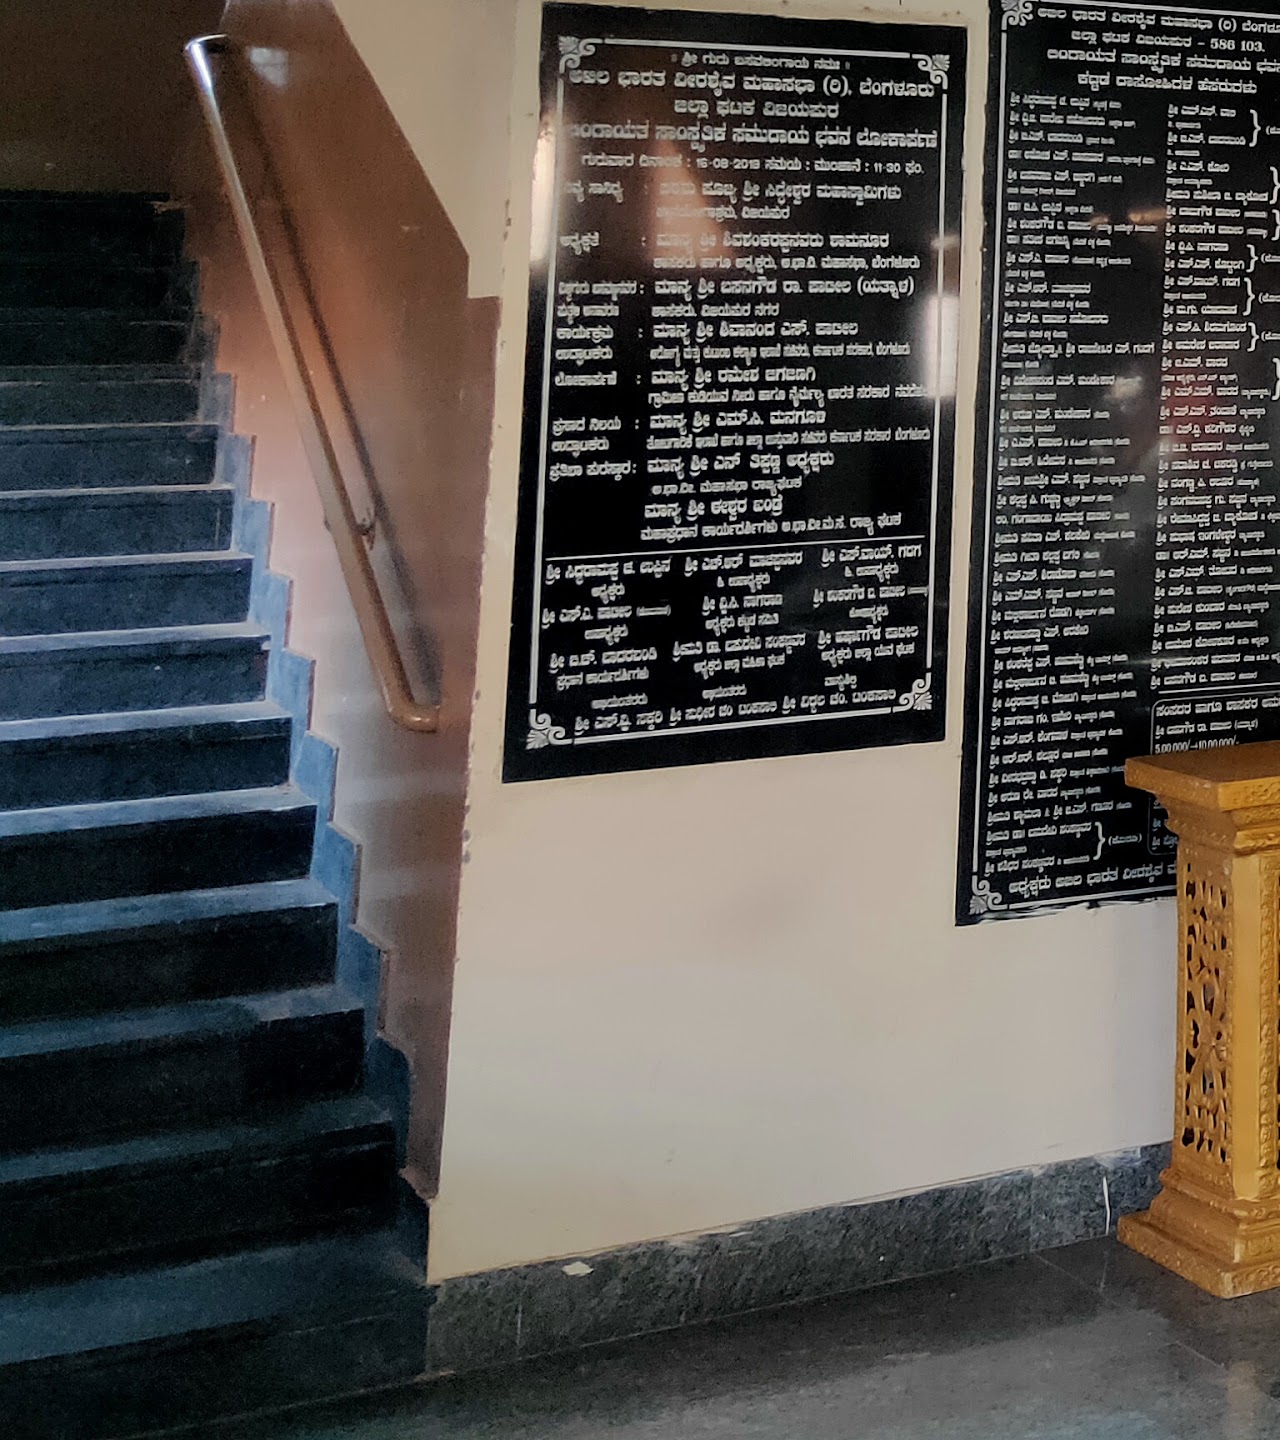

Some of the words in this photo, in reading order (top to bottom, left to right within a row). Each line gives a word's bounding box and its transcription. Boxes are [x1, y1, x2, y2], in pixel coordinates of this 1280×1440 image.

[618, 70, 666, 88] ಭಾರತ
[742, 180, 760, 201] ಶ್ರೀ
[697, 277, 715, 300] ಶ್ರೀ
[695, 320, 713, 343] ಶ್ರೀ
